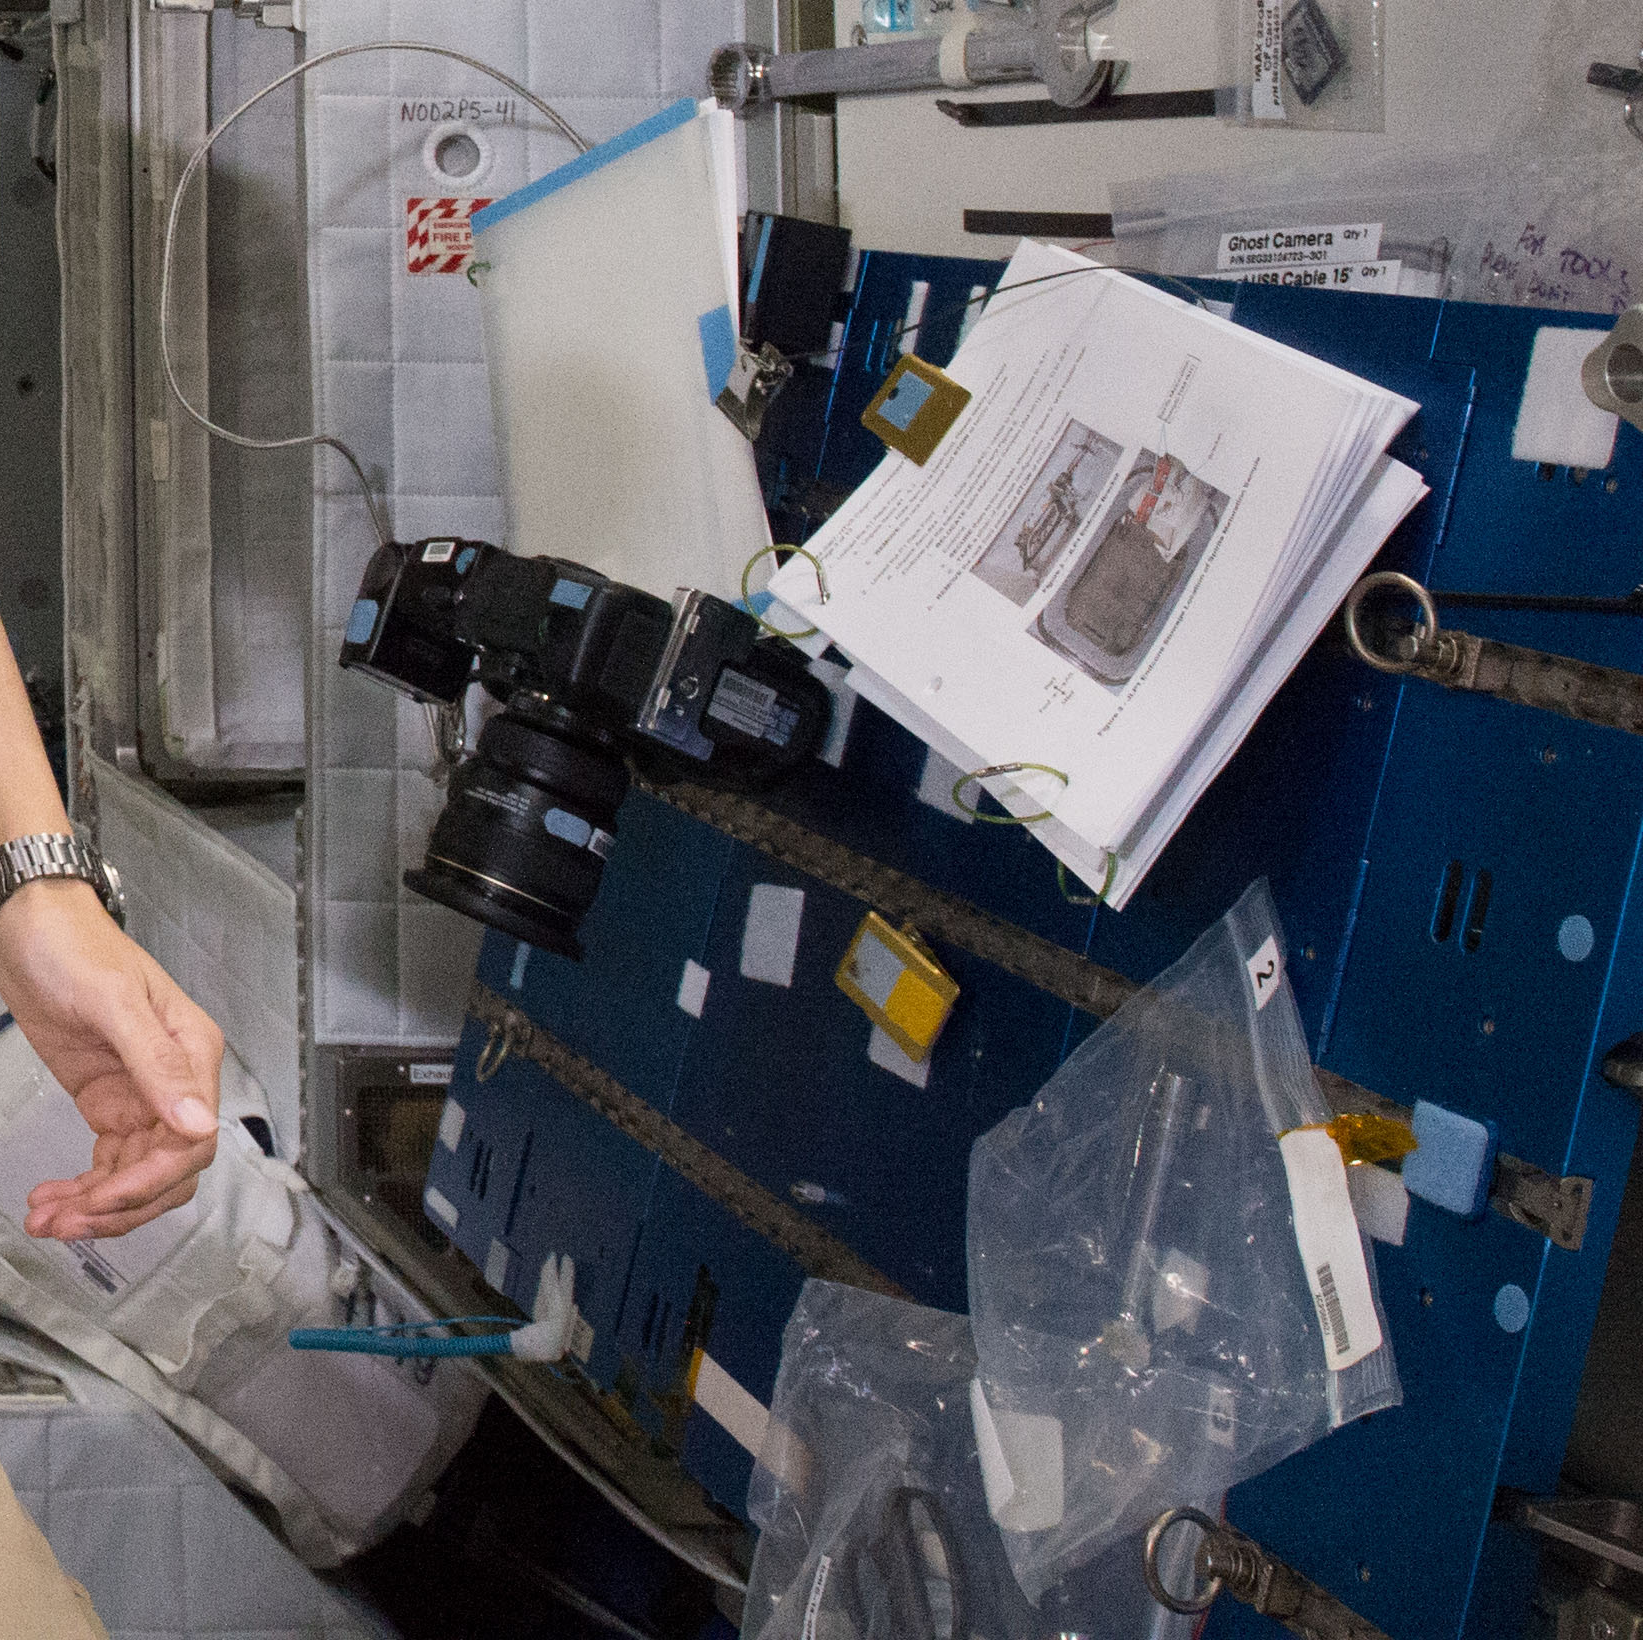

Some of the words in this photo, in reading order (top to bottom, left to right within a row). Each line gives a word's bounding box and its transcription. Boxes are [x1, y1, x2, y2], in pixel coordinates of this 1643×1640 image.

[1265, 10, 1274, 48] Card
[1255, 43, 1263, 82] IMAX
[1264, 51, 1273, 72] CF
[401, 101, 516, 124] NOD2P5-41
[433, 232, 461, 243] FIRE
[1228, 236, 1270, 252] Ghost
[1273, 232, 1333, 249] Camera
[1343, 229, 1360, 241] Qty
[1280, 270, 1327, 287] Cable
[1361, 265, 1379, 278] Qty
[1255, 959, 1275, 990] 2
